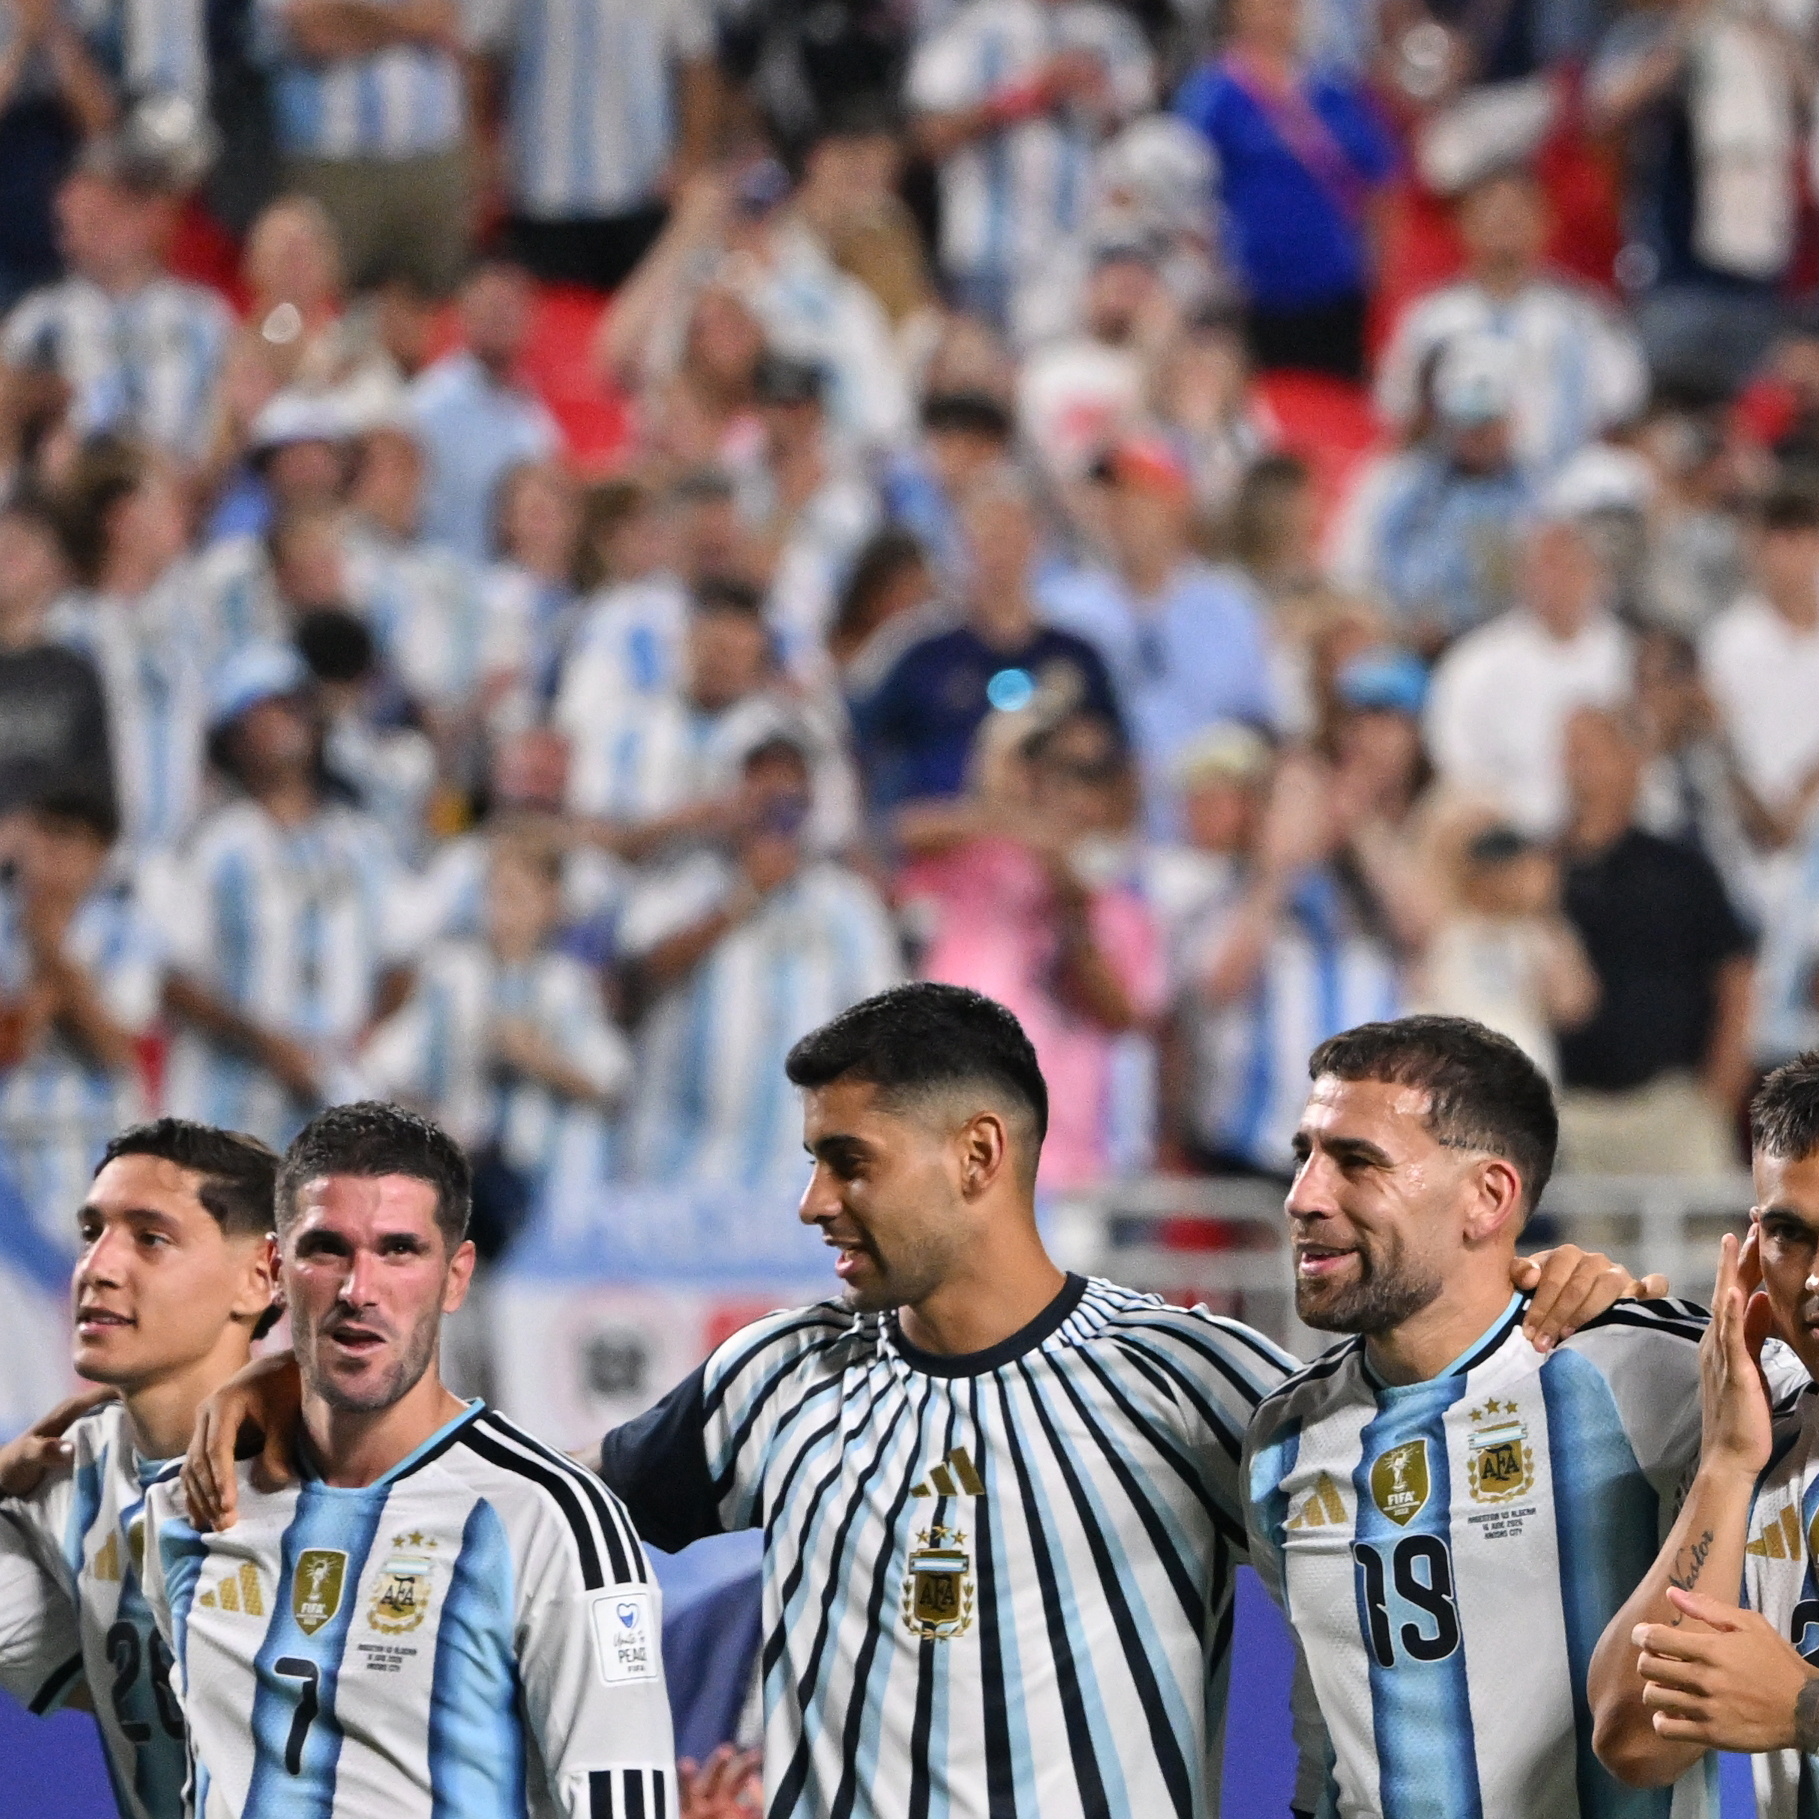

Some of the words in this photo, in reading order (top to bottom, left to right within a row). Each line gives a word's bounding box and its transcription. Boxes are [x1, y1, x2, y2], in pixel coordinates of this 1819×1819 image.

[1481, 1444, 1520, 1481] AFA
[1388, 1492, 1413, 1505] FIFA
[380, 1576, 415, 1612] AFA
[1354, 1535, 1460, 1669] 19
[273, 1656, 320, 1775] 7
